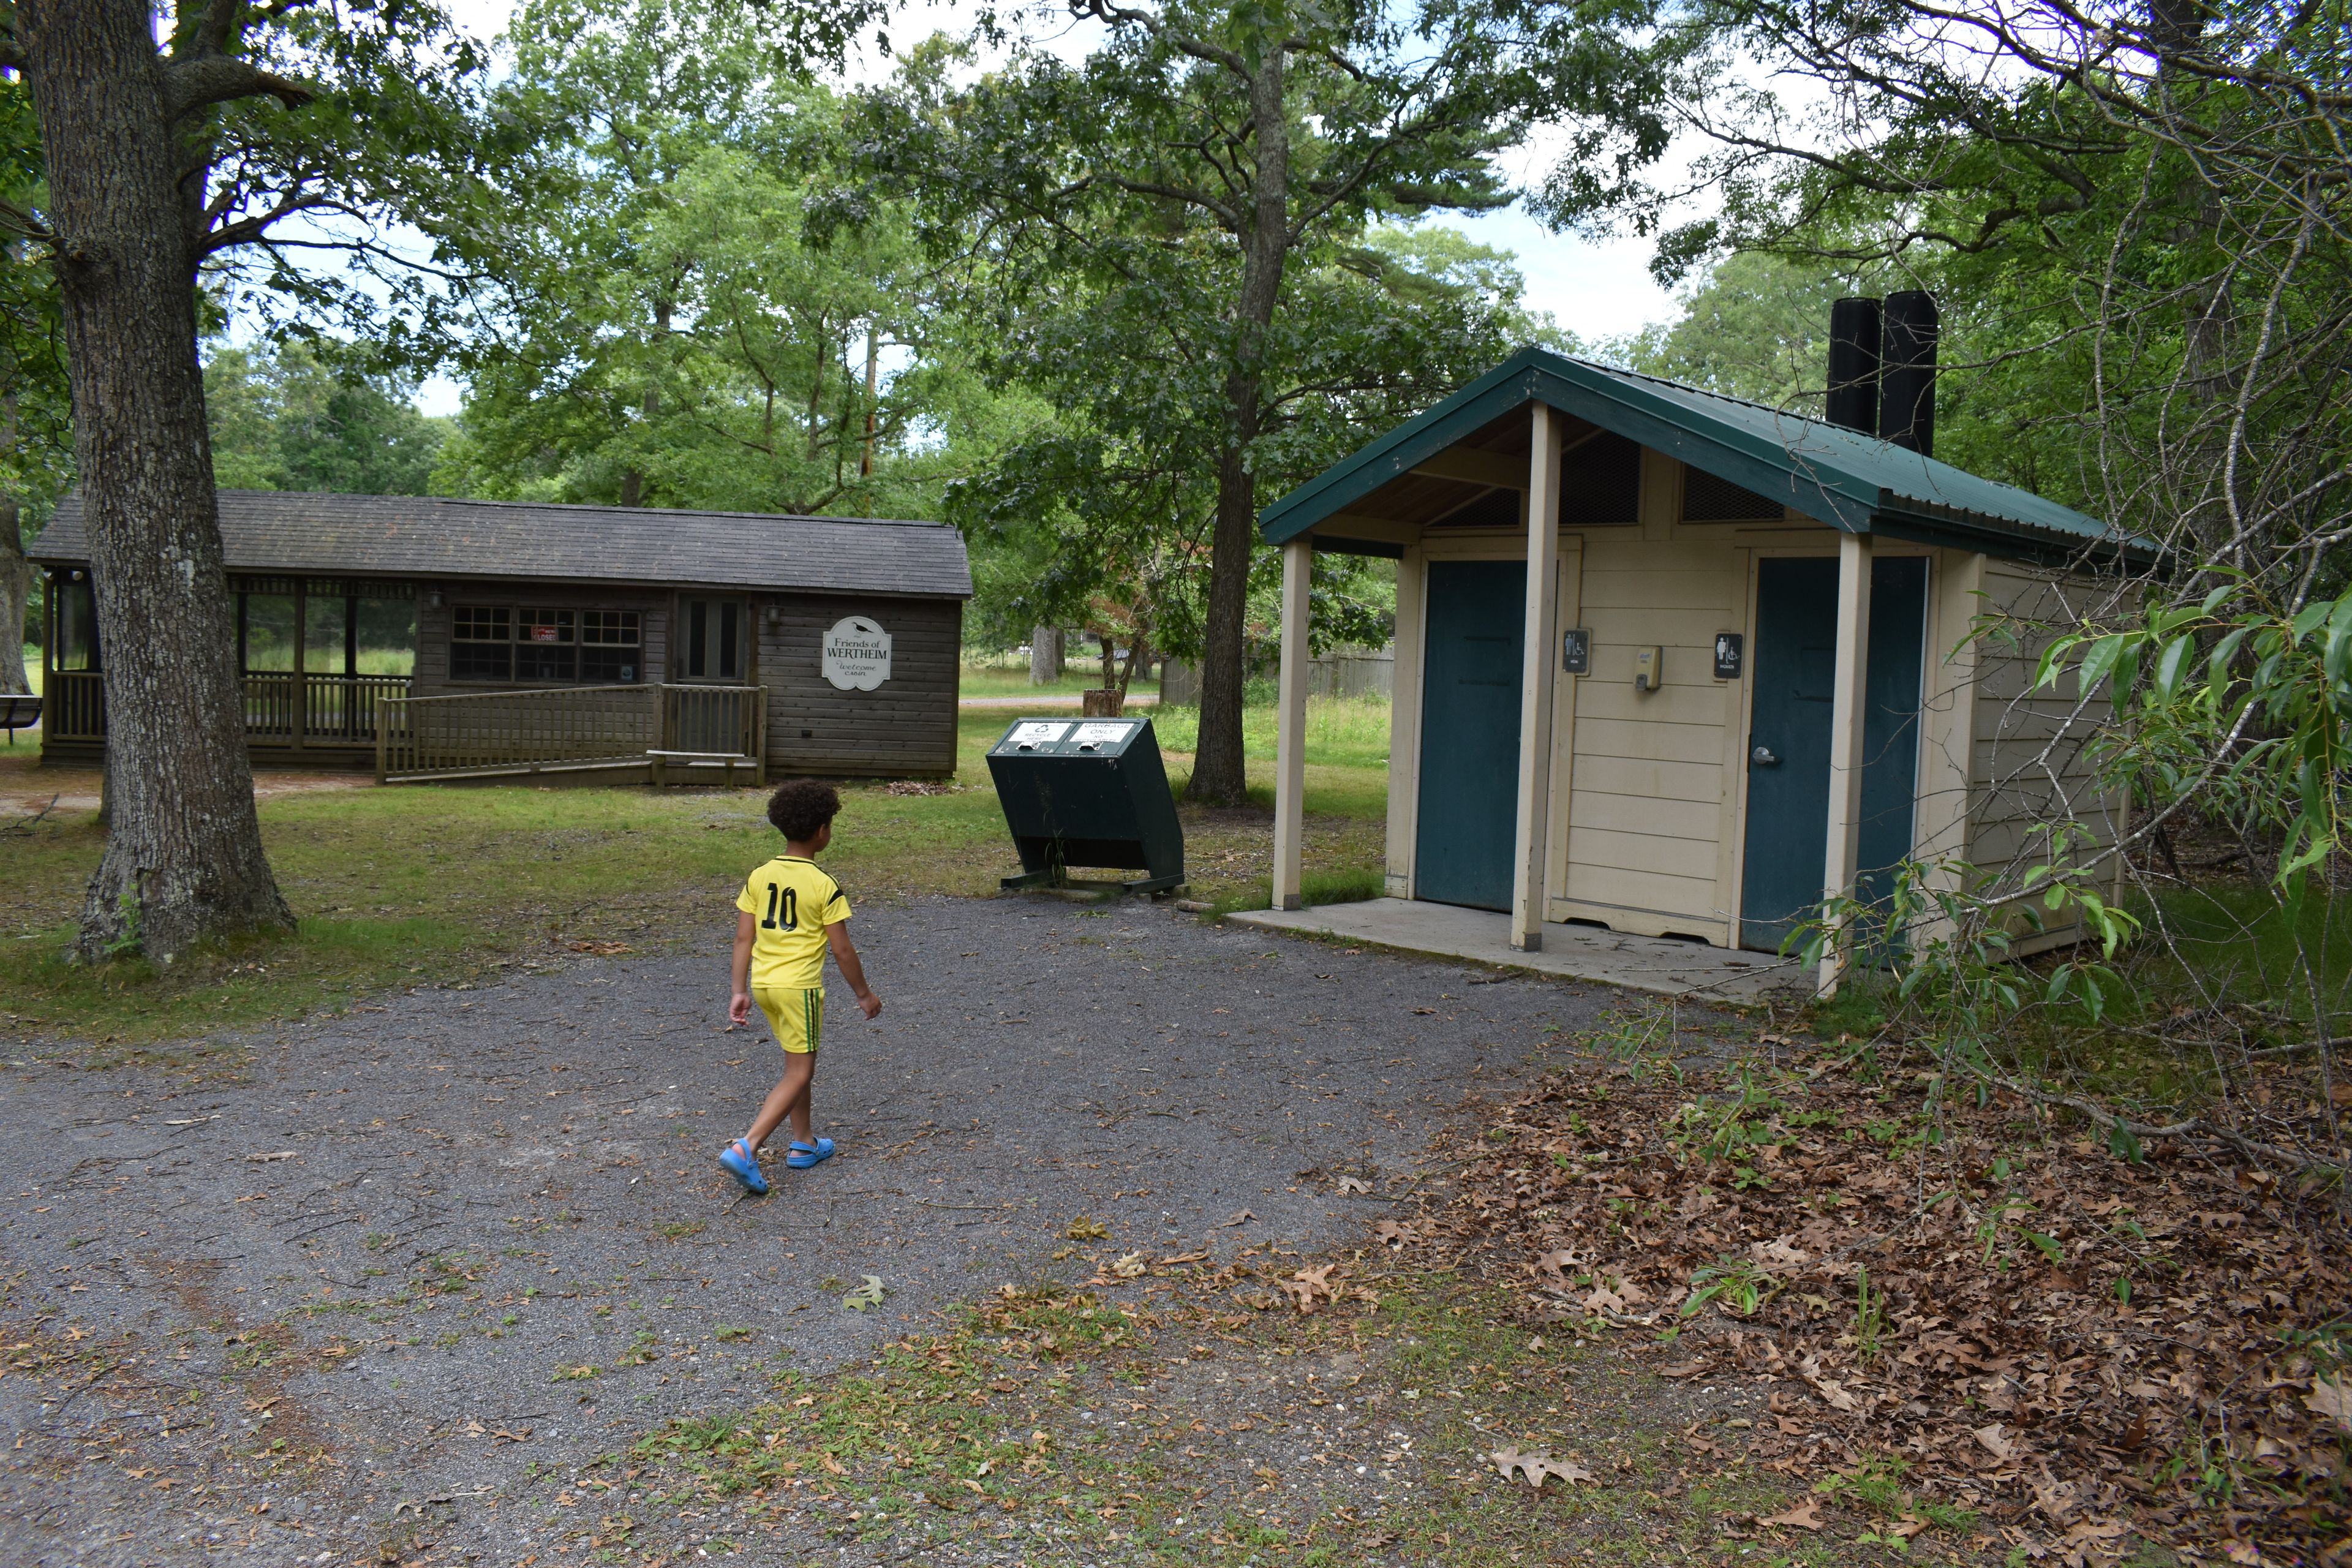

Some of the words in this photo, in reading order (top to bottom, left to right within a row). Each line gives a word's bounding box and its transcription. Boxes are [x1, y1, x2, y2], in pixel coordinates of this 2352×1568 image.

[835, 638, 869, 647] Friends
[827, 647, 888, 660] WERTHEIM
[835, 660, 876, 671] Welcome
[761, 882, 798, 932] 10
